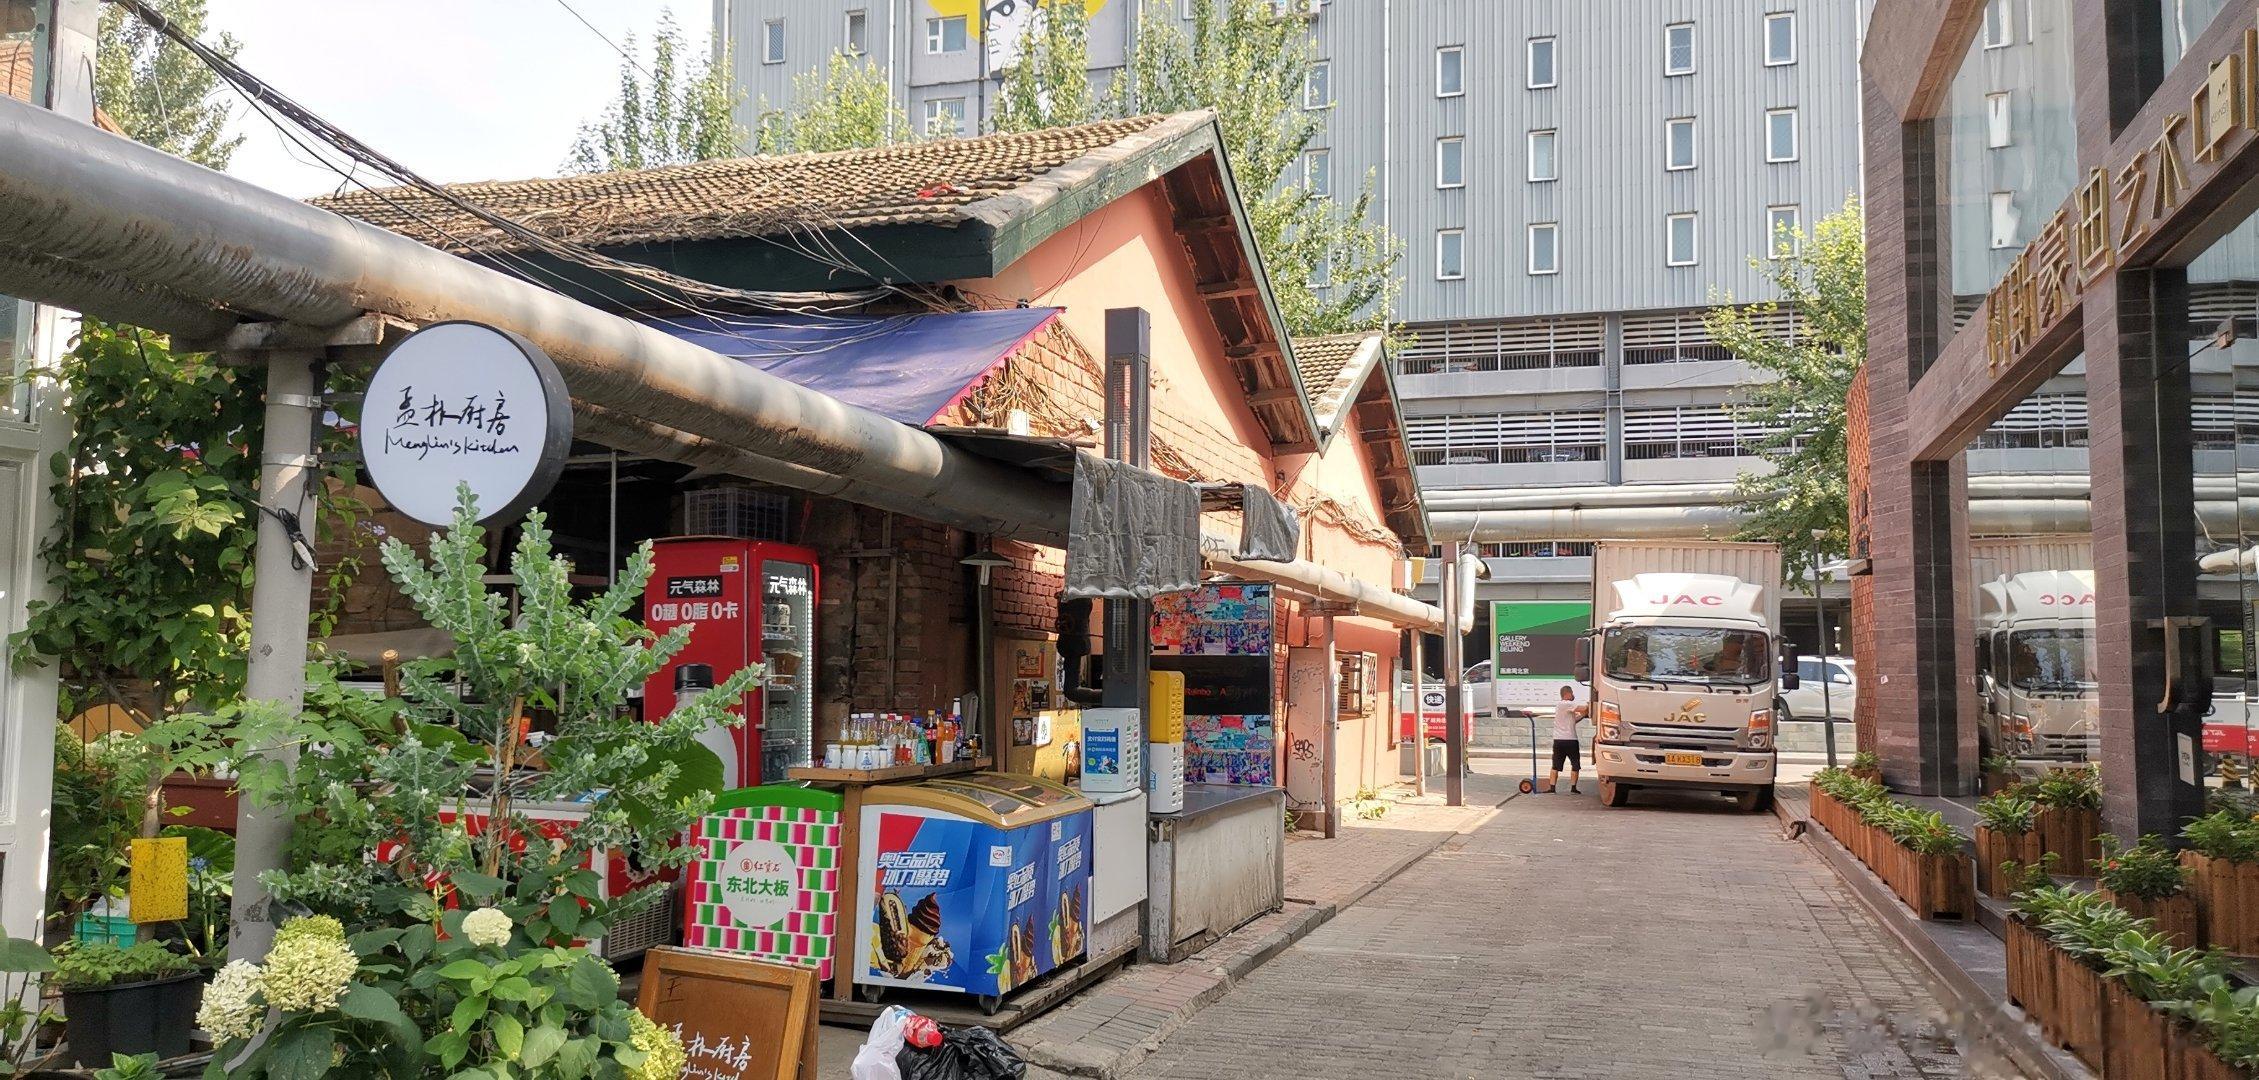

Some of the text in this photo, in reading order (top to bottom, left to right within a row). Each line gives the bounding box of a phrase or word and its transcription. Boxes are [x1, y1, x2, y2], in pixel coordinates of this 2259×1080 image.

[670, 579, 720, 595] 元气森林
[769, 576, 808, 596] 元气森林
[1650, 594, 1723, 606] JAC
[1664, 712, 1707, 723] JAC
[877, 851, 946, 869] 奥运品质
[882, 869, 950, 886] 冰力聚势
[726, 876, 789, 897] 东北大板
